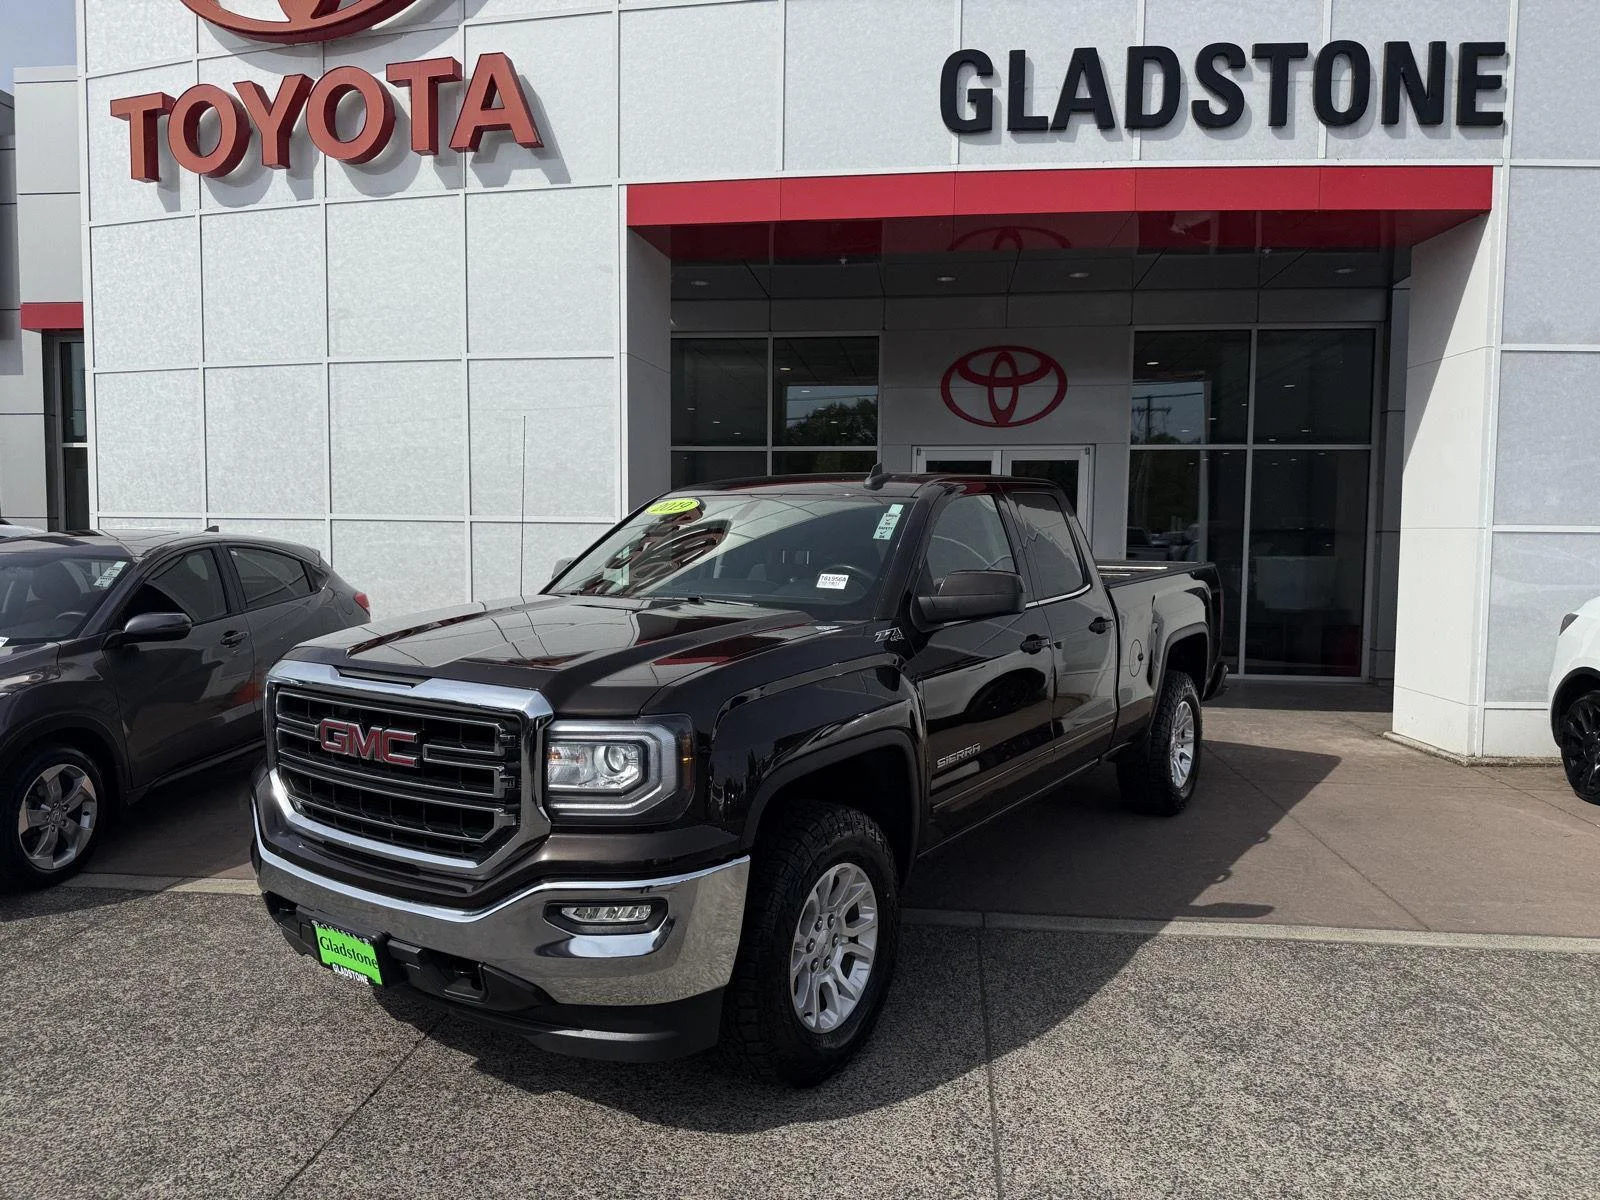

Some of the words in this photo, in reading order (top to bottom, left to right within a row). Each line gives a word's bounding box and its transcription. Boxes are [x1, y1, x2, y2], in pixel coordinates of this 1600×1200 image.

[939, 39, 1506, 134] GLADSTONE
[110, 52, 545, 183] TOYOTA
[319, 717, 419, 769] GMC
[937, 742, 982, 768] SIERRA
[319, 936, 379, 970] Gladstone
